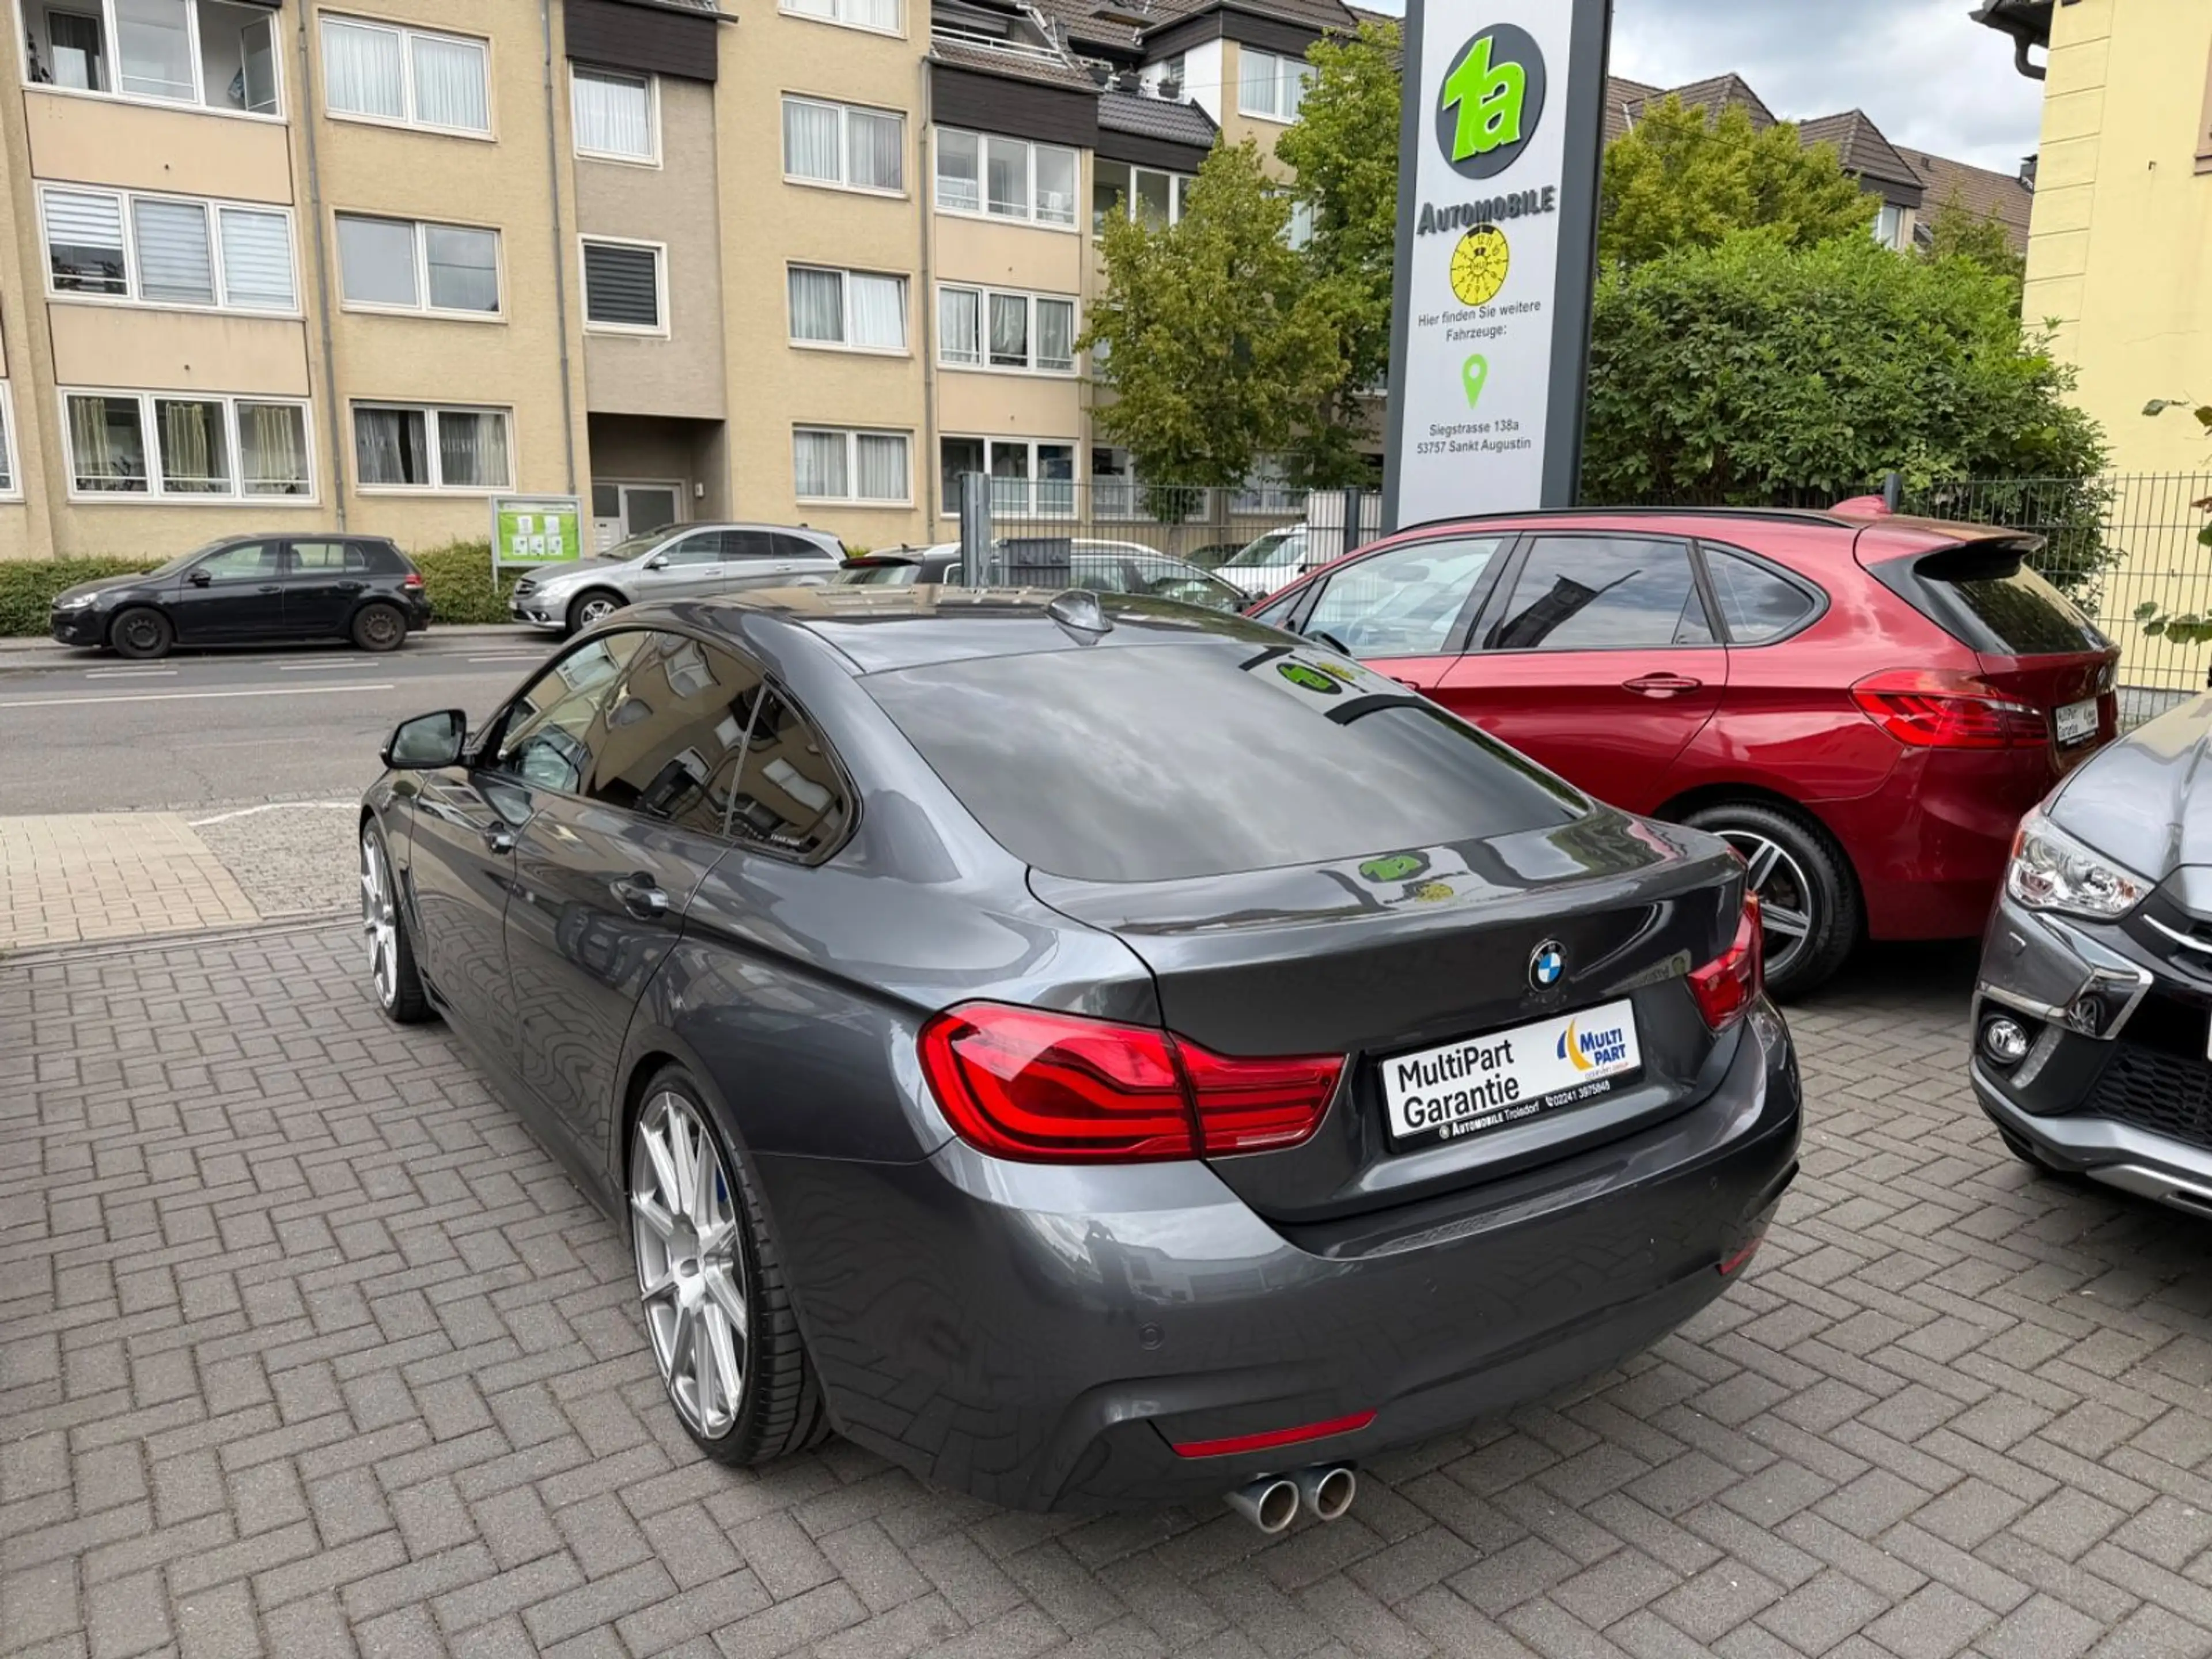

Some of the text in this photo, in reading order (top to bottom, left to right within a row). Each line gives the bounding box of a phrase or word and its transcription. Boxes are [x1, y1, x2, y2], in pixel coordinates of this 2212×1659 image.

[1442, 35, 1525, 161] 1a
[1417, 185, 1556, 235] AUTOMOBILE
[1418, 300, 1541, 327] Hier finden Sie weitere
[1446, 324, 1507, 342] Fahrzeuge:
[1429, 419, 1519, 438] Siegstrasse 138a
[1417, 436, 1532, 454] 53757 Sankt Augustin
[1580, 1028, 1623, 1052] MULTI
[1397, 1039, 1514, 1093] MultiPart
[1594, 1043, 1626, 1065] PART
[1403, 1073, 1520, 1128] Garantie
